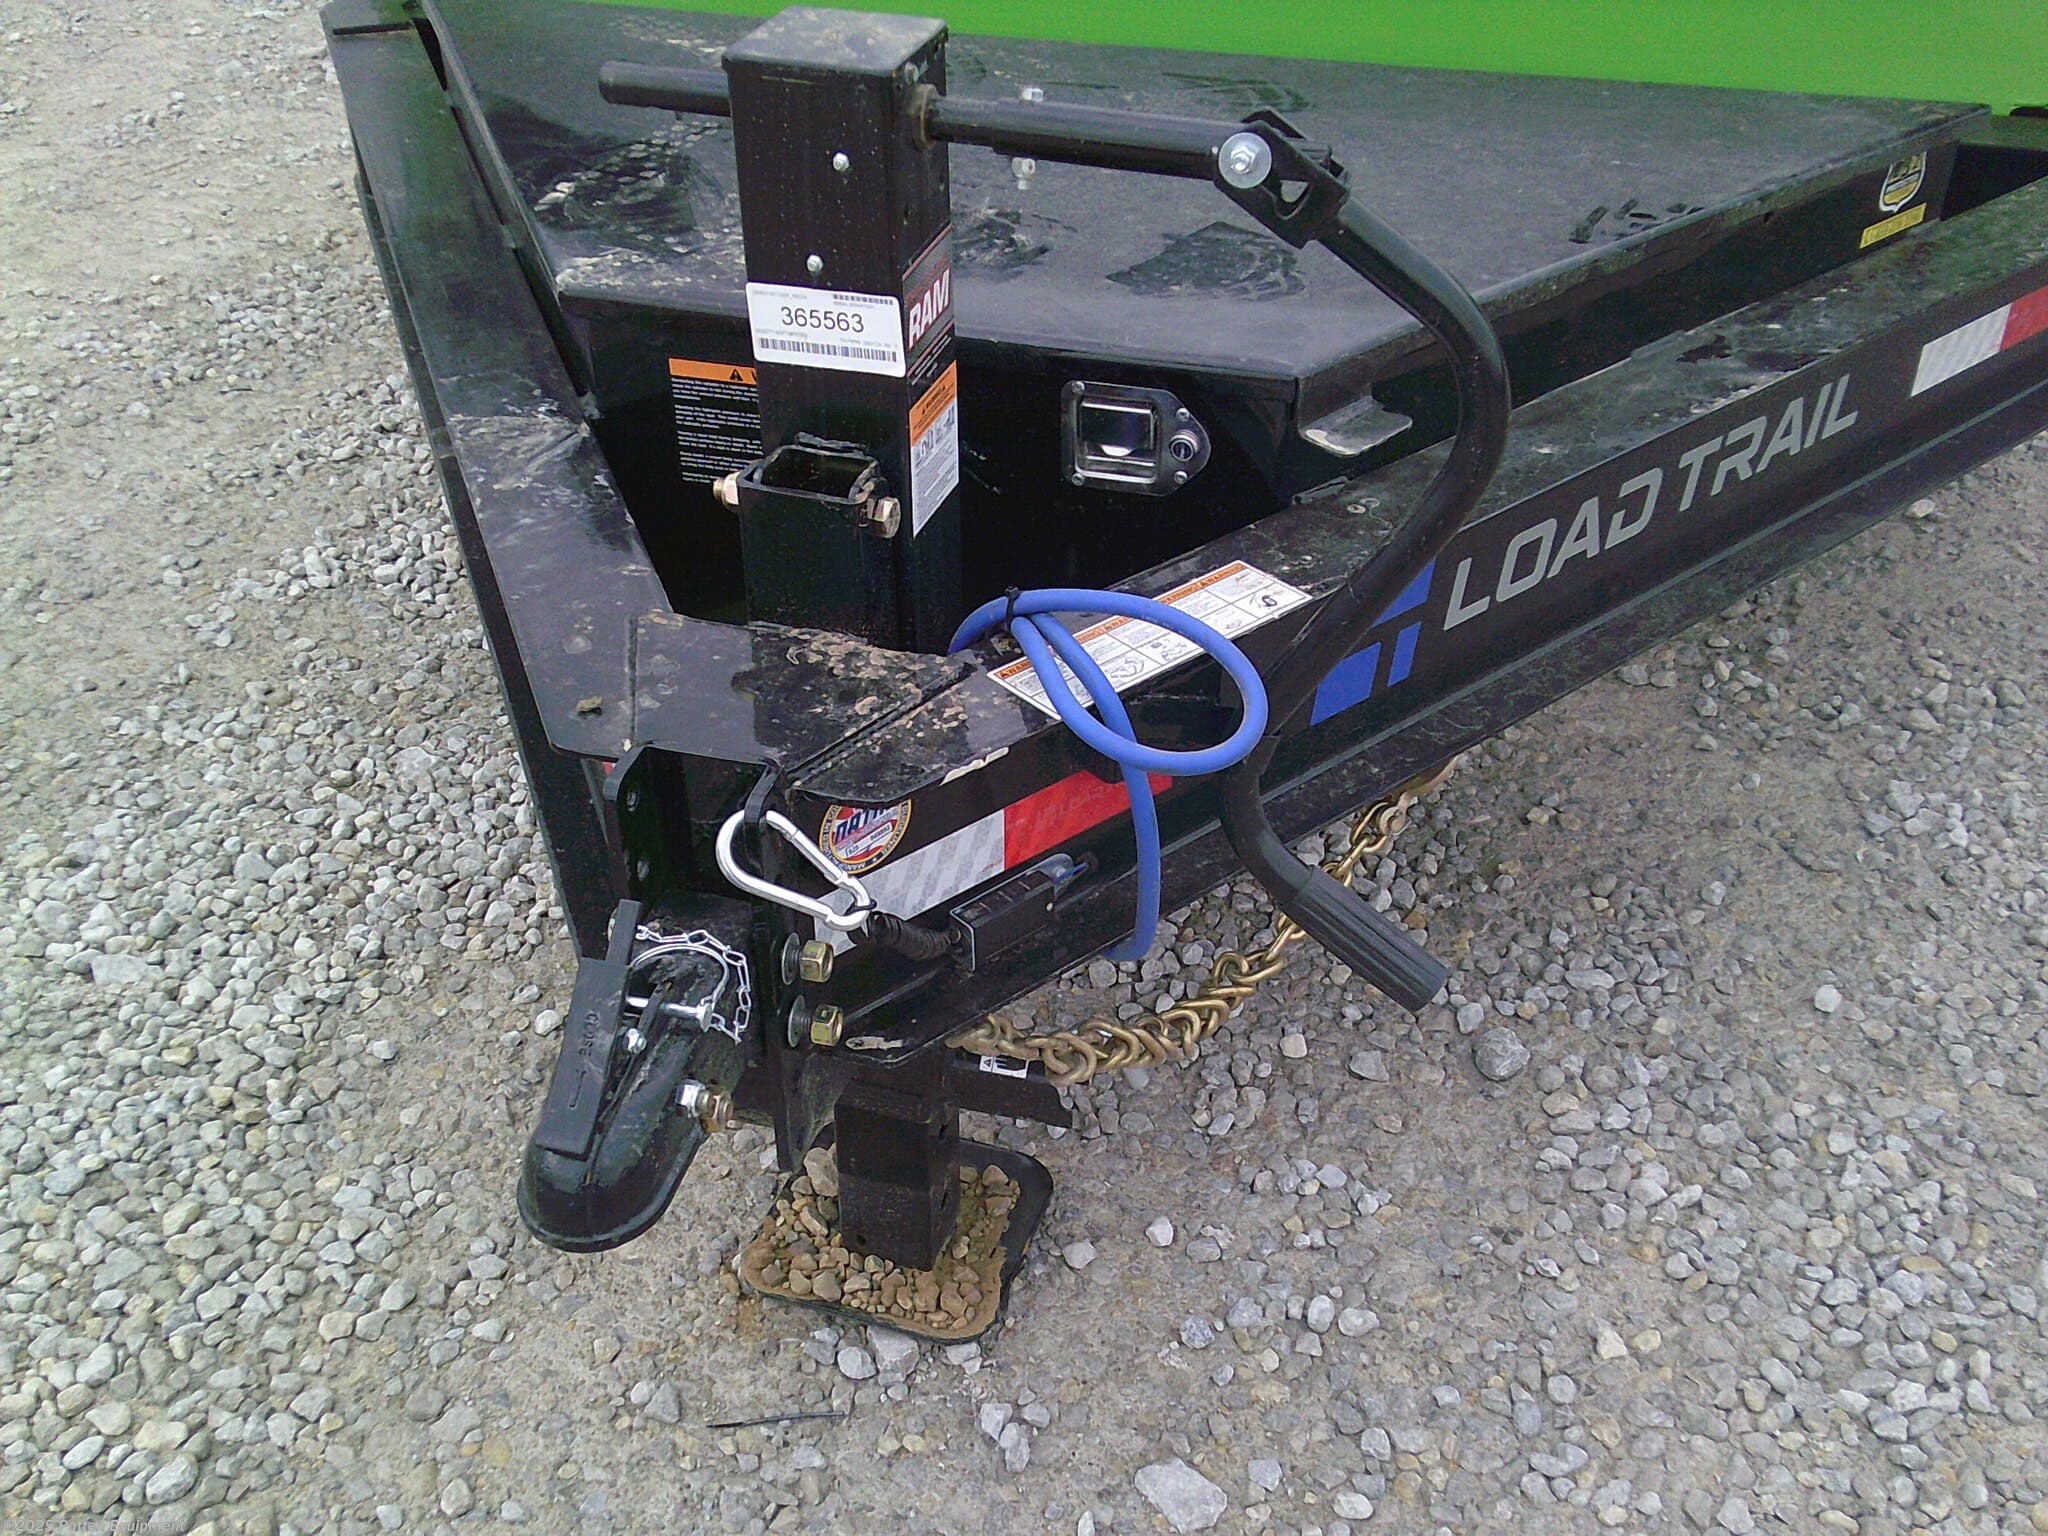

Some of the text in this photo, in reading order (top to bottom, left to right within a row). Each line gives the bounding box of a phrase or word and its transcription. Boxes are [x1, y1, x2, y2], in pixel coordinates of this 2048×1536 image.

[780, 306, 865, 333] 365563
[908, 268, 950, 350] RAM
[1443, 373, 1859, 631] LOAD TRAIL
